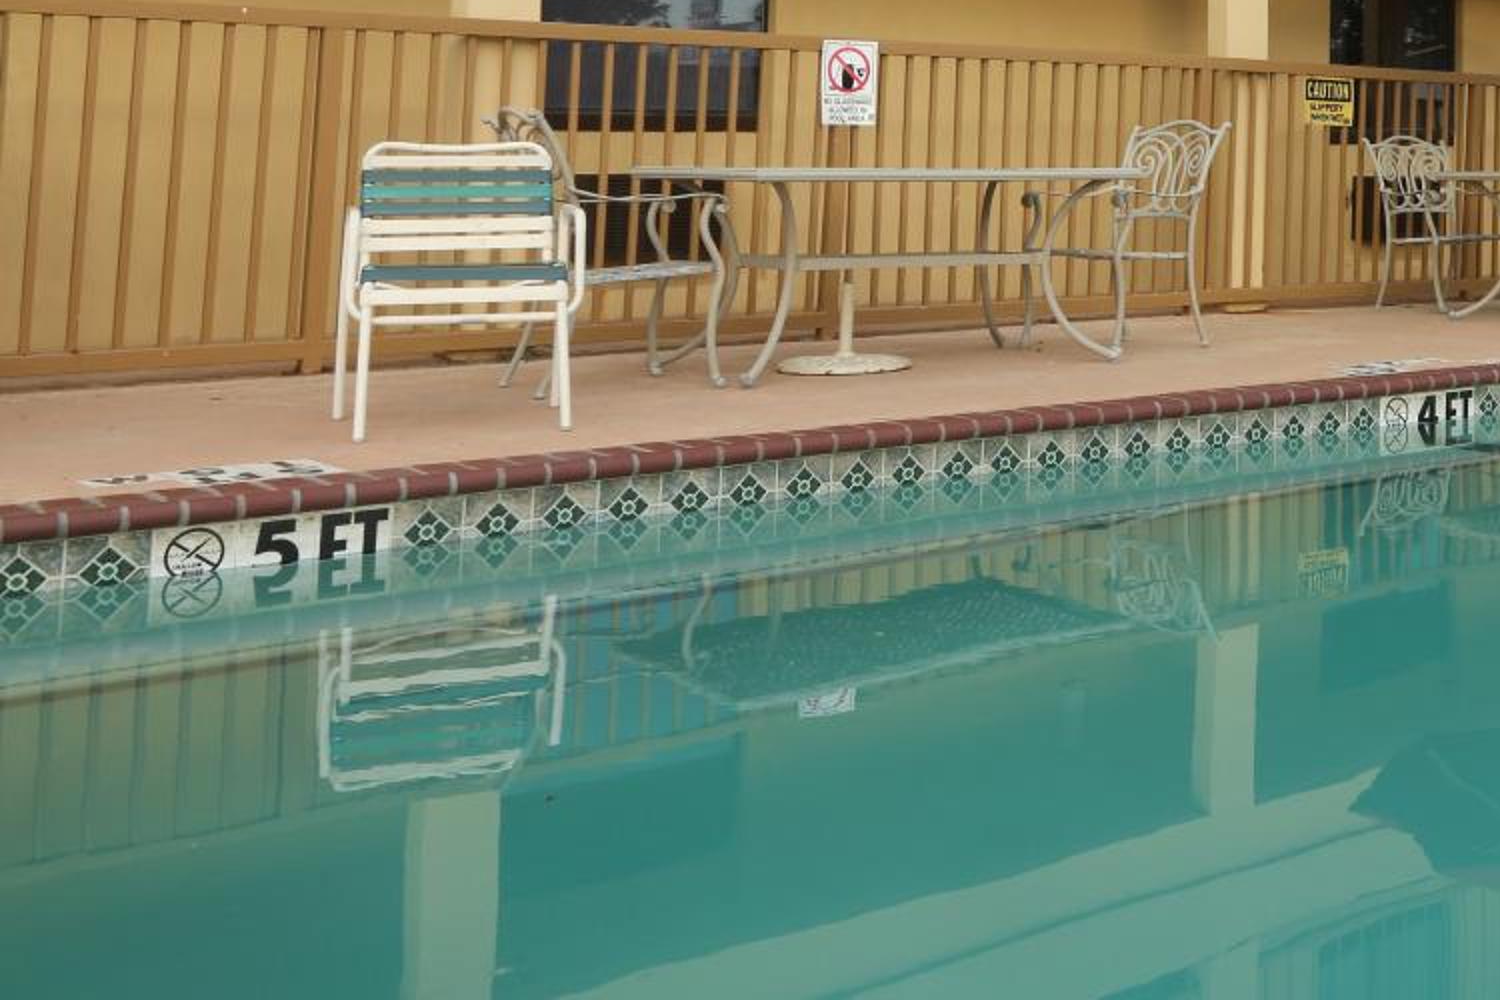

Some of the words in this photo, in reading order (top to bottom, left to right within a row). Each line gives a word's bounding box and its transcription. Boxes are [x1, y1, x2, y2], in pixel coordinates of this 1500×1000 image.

[1308, 81, 1349, 99] CAUTION
[1311, 103, 1343, 112] SLIPPERY
[1418, 395, 1439, 422] 4
[253, 518, 299, 567] 5
[320, 508, 389, 560] FT
